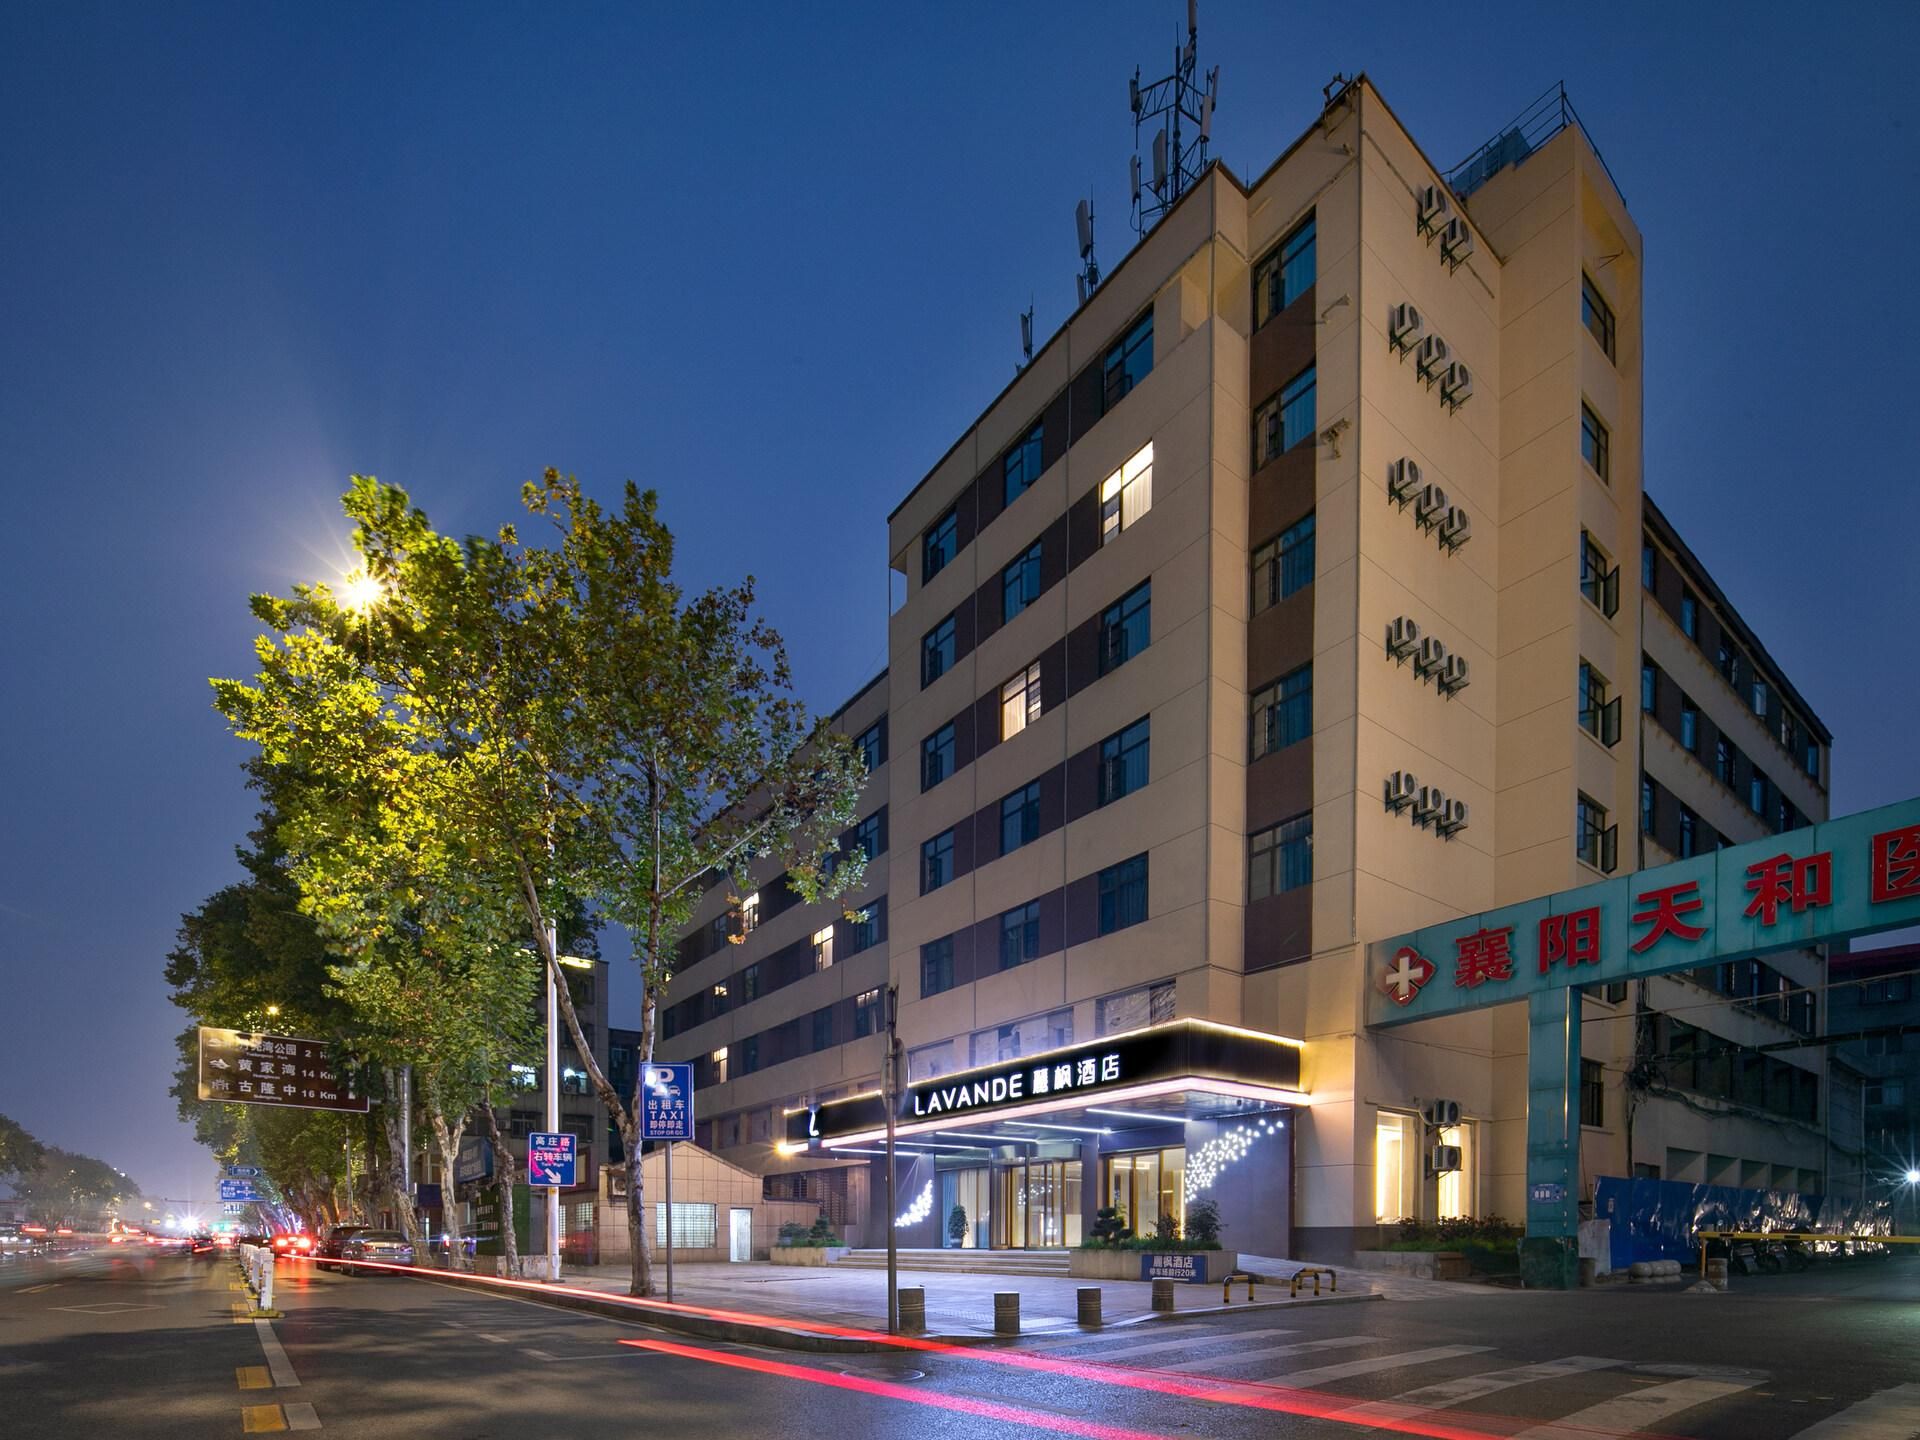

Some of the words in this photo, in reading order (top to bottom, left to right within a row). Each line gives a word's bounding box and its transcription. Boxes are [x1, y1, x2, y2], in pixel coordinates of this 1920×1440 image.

[304, 1049, 312, 1058] 2
[238, 1058, 296, 1077] 黄家湾
[302, 1069, 315, 1079] 14
[238, 1080, 297, 1097] 古隆中
[302, 1089, 315, 1099] 16
[320, 1091, 337, 1100] Km
[914, 1073, 1023, 1116] LAVANDE
[648, 1099, 685, 1110] 出租车
[650, 1111, 684, 1120] TAXI
[649, 1120, 684, 1130] 即停即走
[535, 1136, 570, 1147] 高庄路
[533, 1151, 573, 1162] 右转车辆
